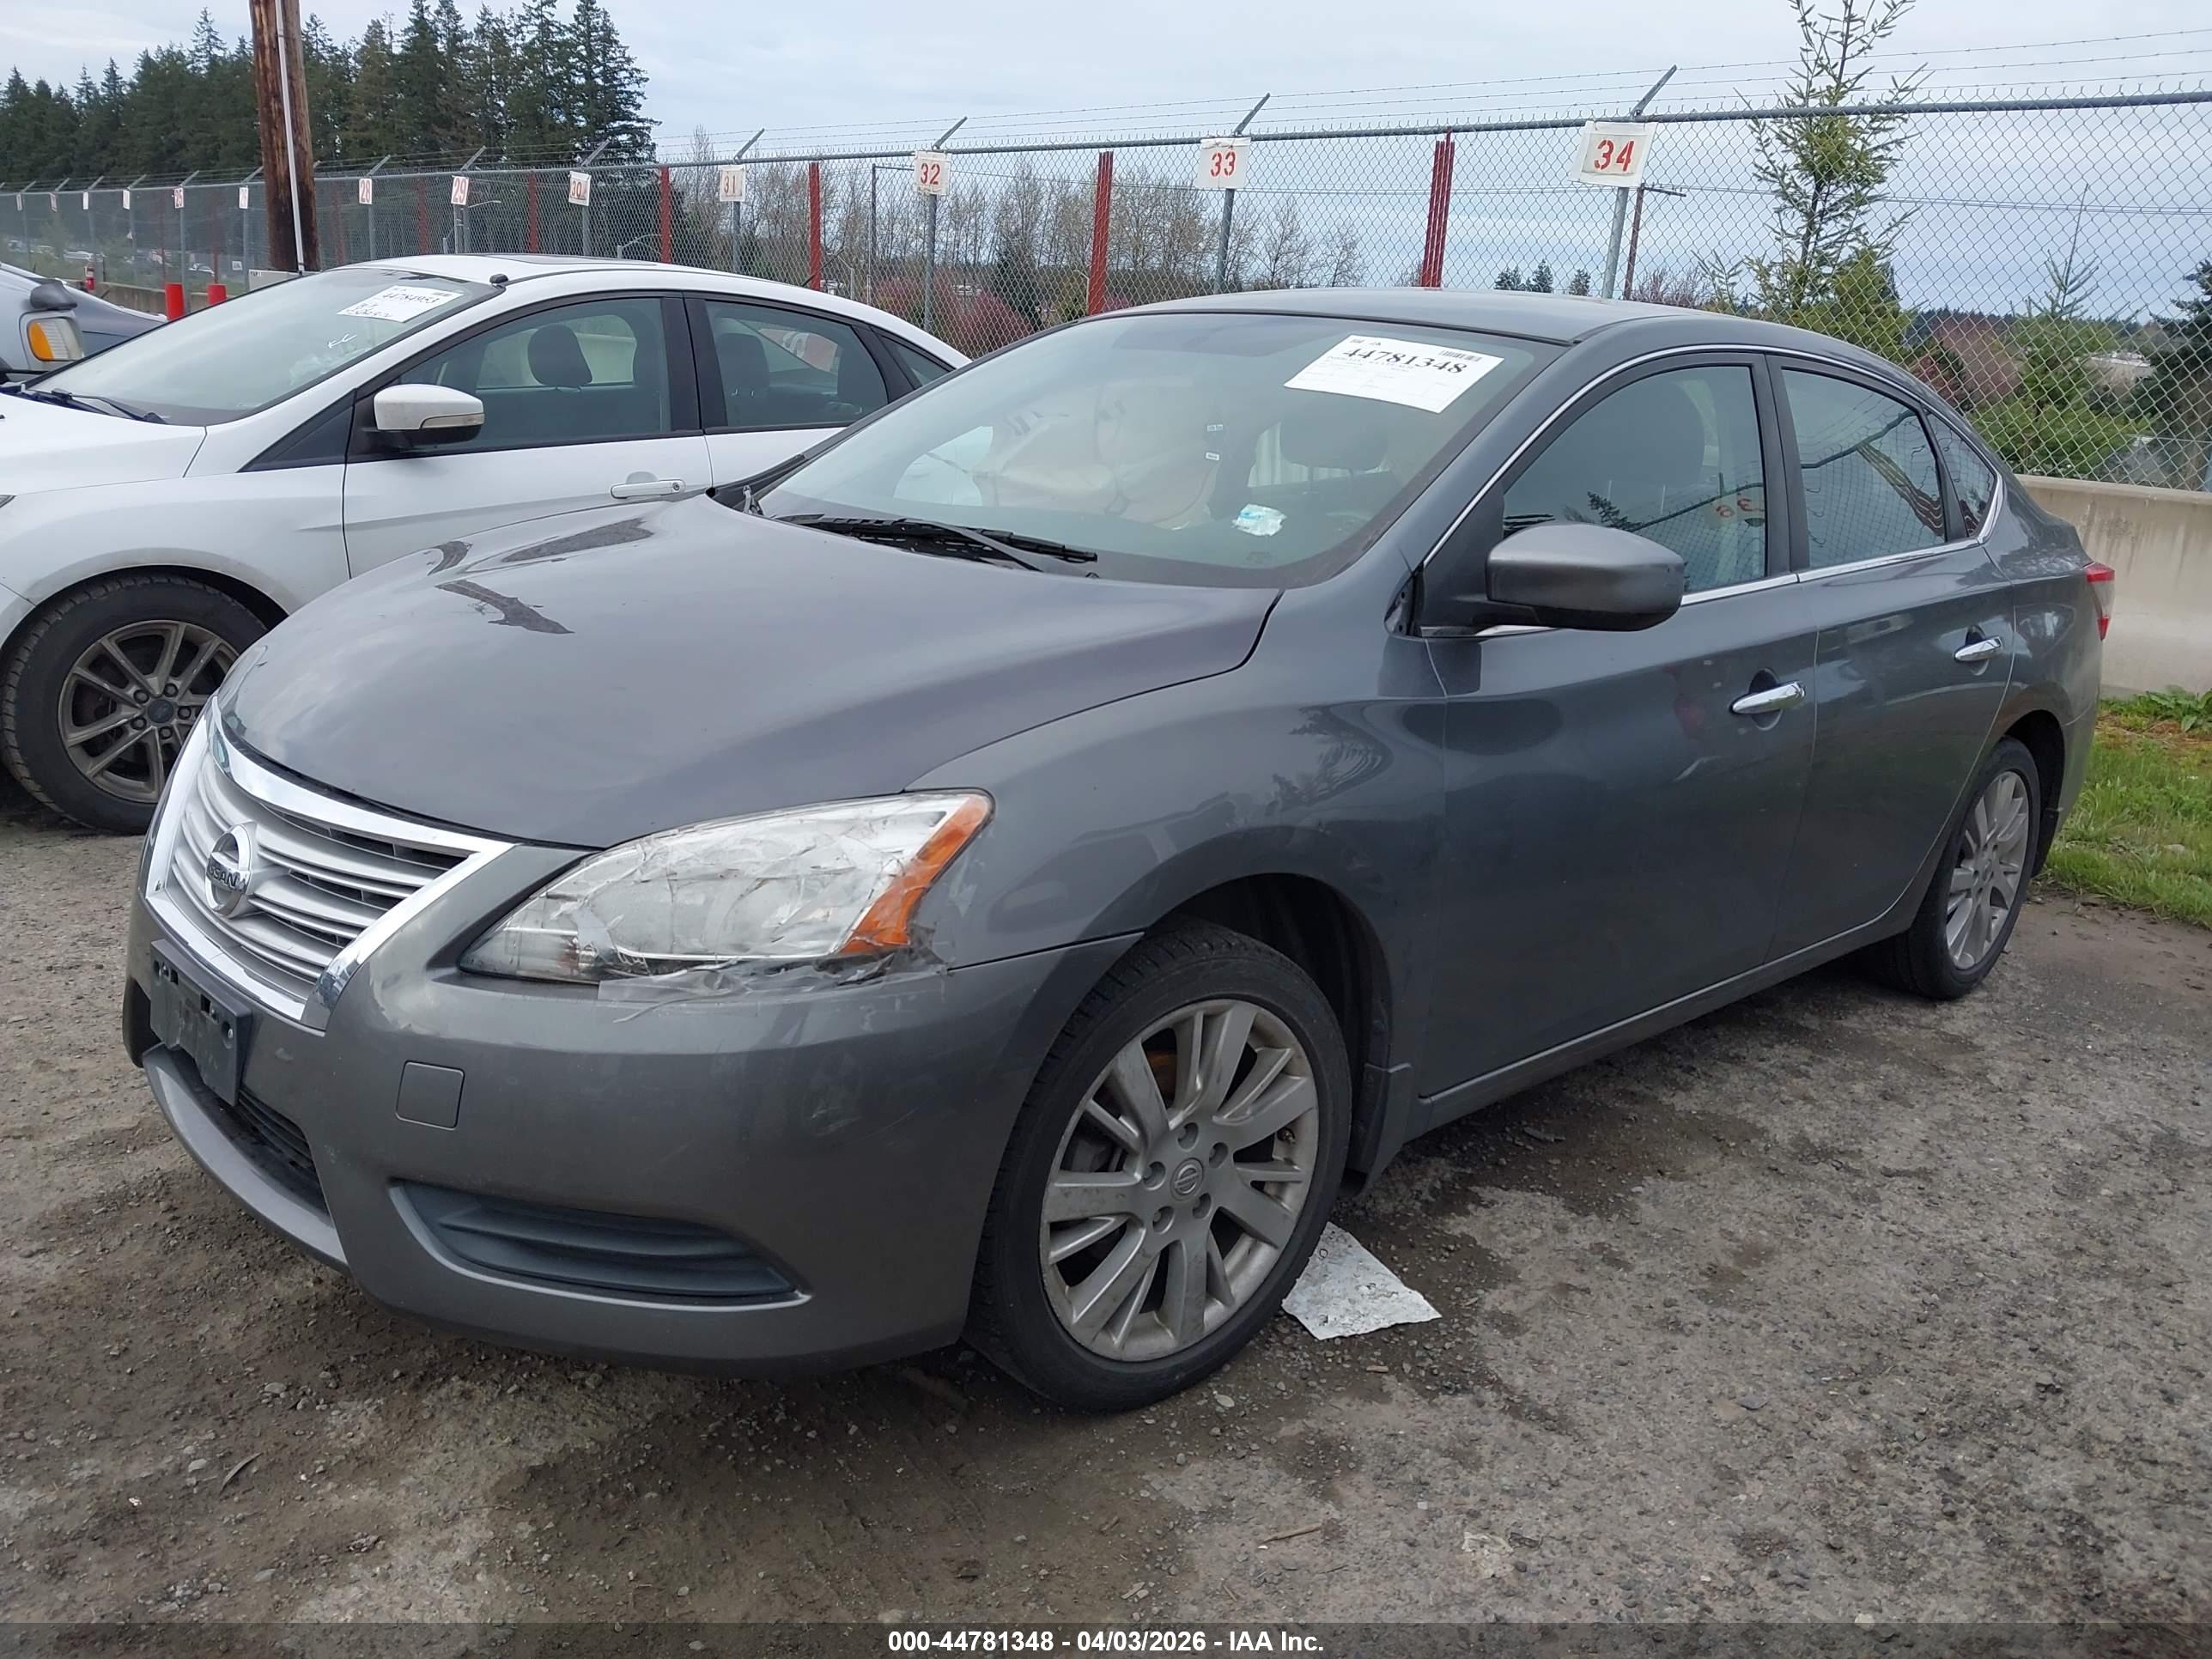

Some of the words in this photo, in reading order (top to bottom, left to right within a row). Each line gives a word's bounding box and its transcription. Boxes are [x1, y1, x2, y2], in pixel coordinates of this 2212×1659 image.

[1211, 151, 1237, 177] 33
[1594, 139, 1635, 172] 34
[724, 175, 736, 194] 31
[921, 162, 940, 185] 32
[361, 179, 371, 204] 28
[453, 178, 467, 204] 29
[571, 180, 582, 198] 30
[1343, 348, 1468, 374] 44781348
